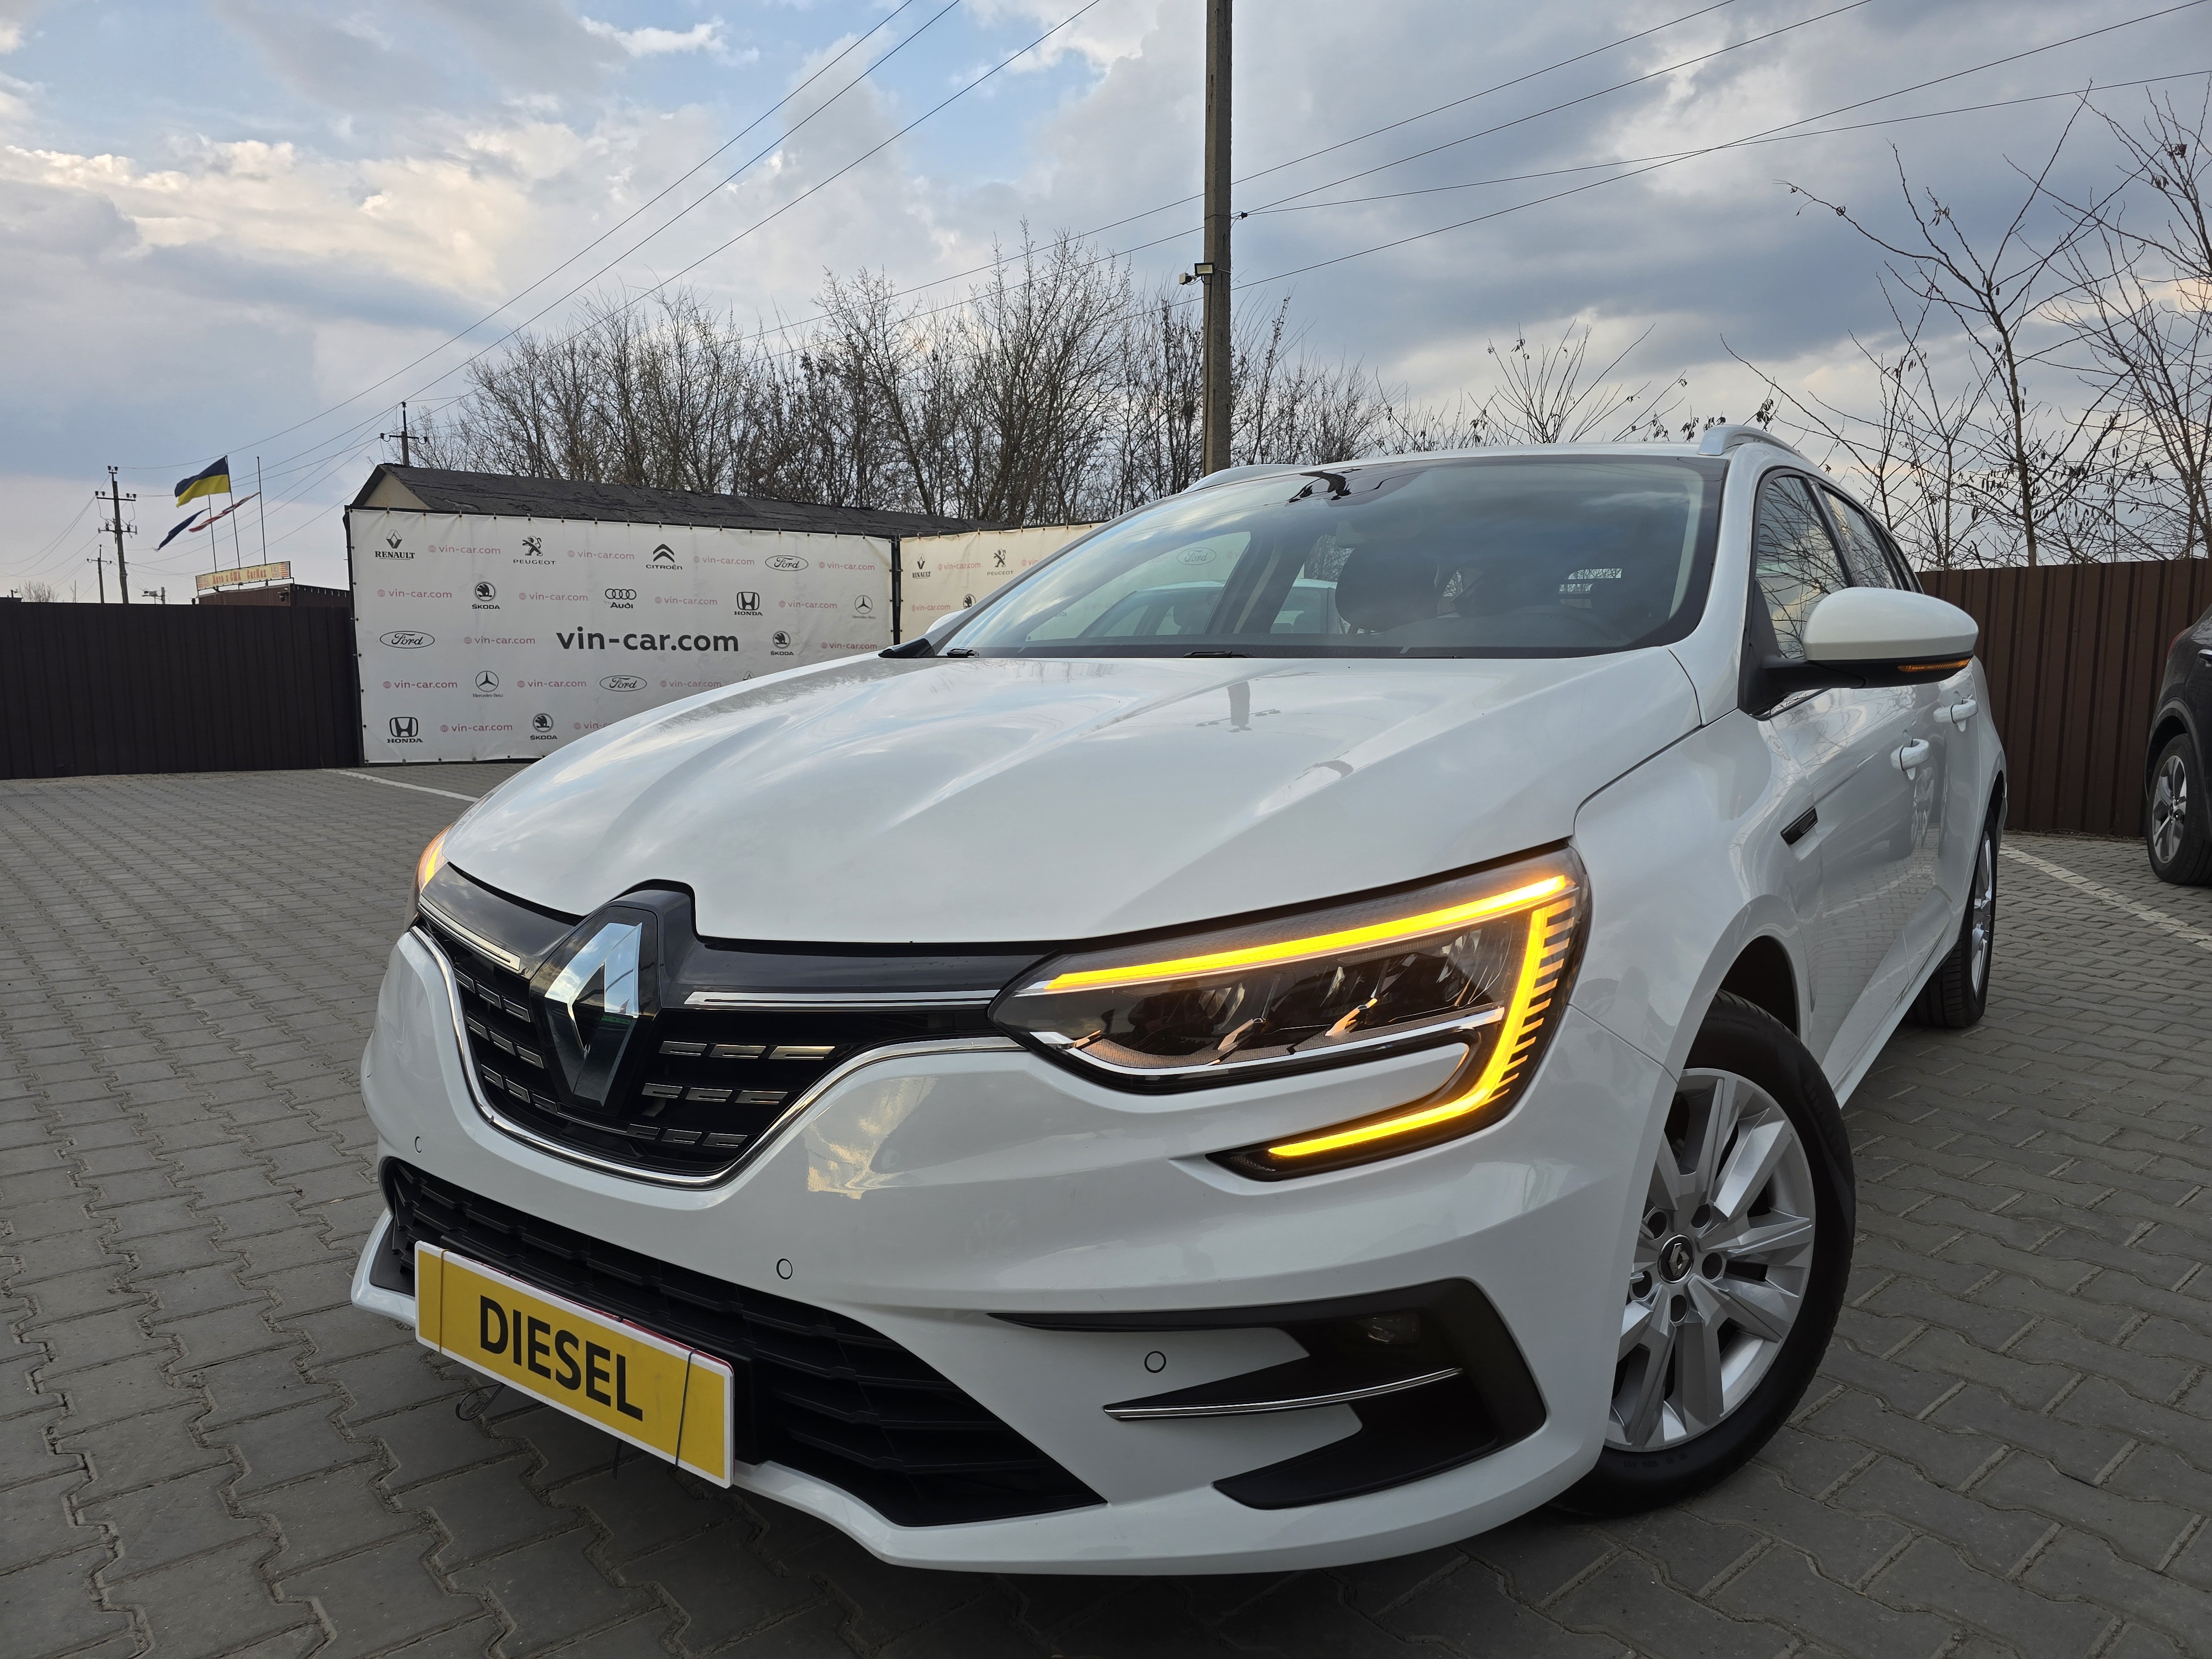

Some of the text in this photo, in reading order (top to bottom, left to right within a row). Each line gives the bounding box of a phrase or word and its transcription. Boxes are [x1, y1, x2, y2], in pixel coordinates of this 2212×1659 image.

[439, 544, 500, 555] vin-car.com
[577, 549, 634, 560] vin-car.com
[702, 555, 754, 566] vin-car.com
[1185, 550, 1208, 562] Ford
[774, 557, 799, 568] Ford
[827, 561, 875, 571] vin-car.com
[944, 561, 980, 570] vin-car.com
[388, 588, 452, 598] vin-car.com
[529, 592, 588, 601] vin-car.com
[664, 596, 718, 606] vin-car.com
[788, 601, 838, 609] vin-car.com
[916, 603, 951, 612] vin-car.com
[391, 632, 423, 645] Ford
[474, 635, 536, 644] vin-car.com
[556, 627, 739, 652] vin-car.com
[829, 641, 878, 650] vin-car.com
[394, 680, 458, 688] vin-car.com
[527, 679, 587, 687] vin-car.com
[609, 677, 637, 689] Ford
[669, 679, 722, 688] vin-car.com
[451, 723, 513, 732] vin-car.com
[480, 1295, 643, 1422] DIESEL
